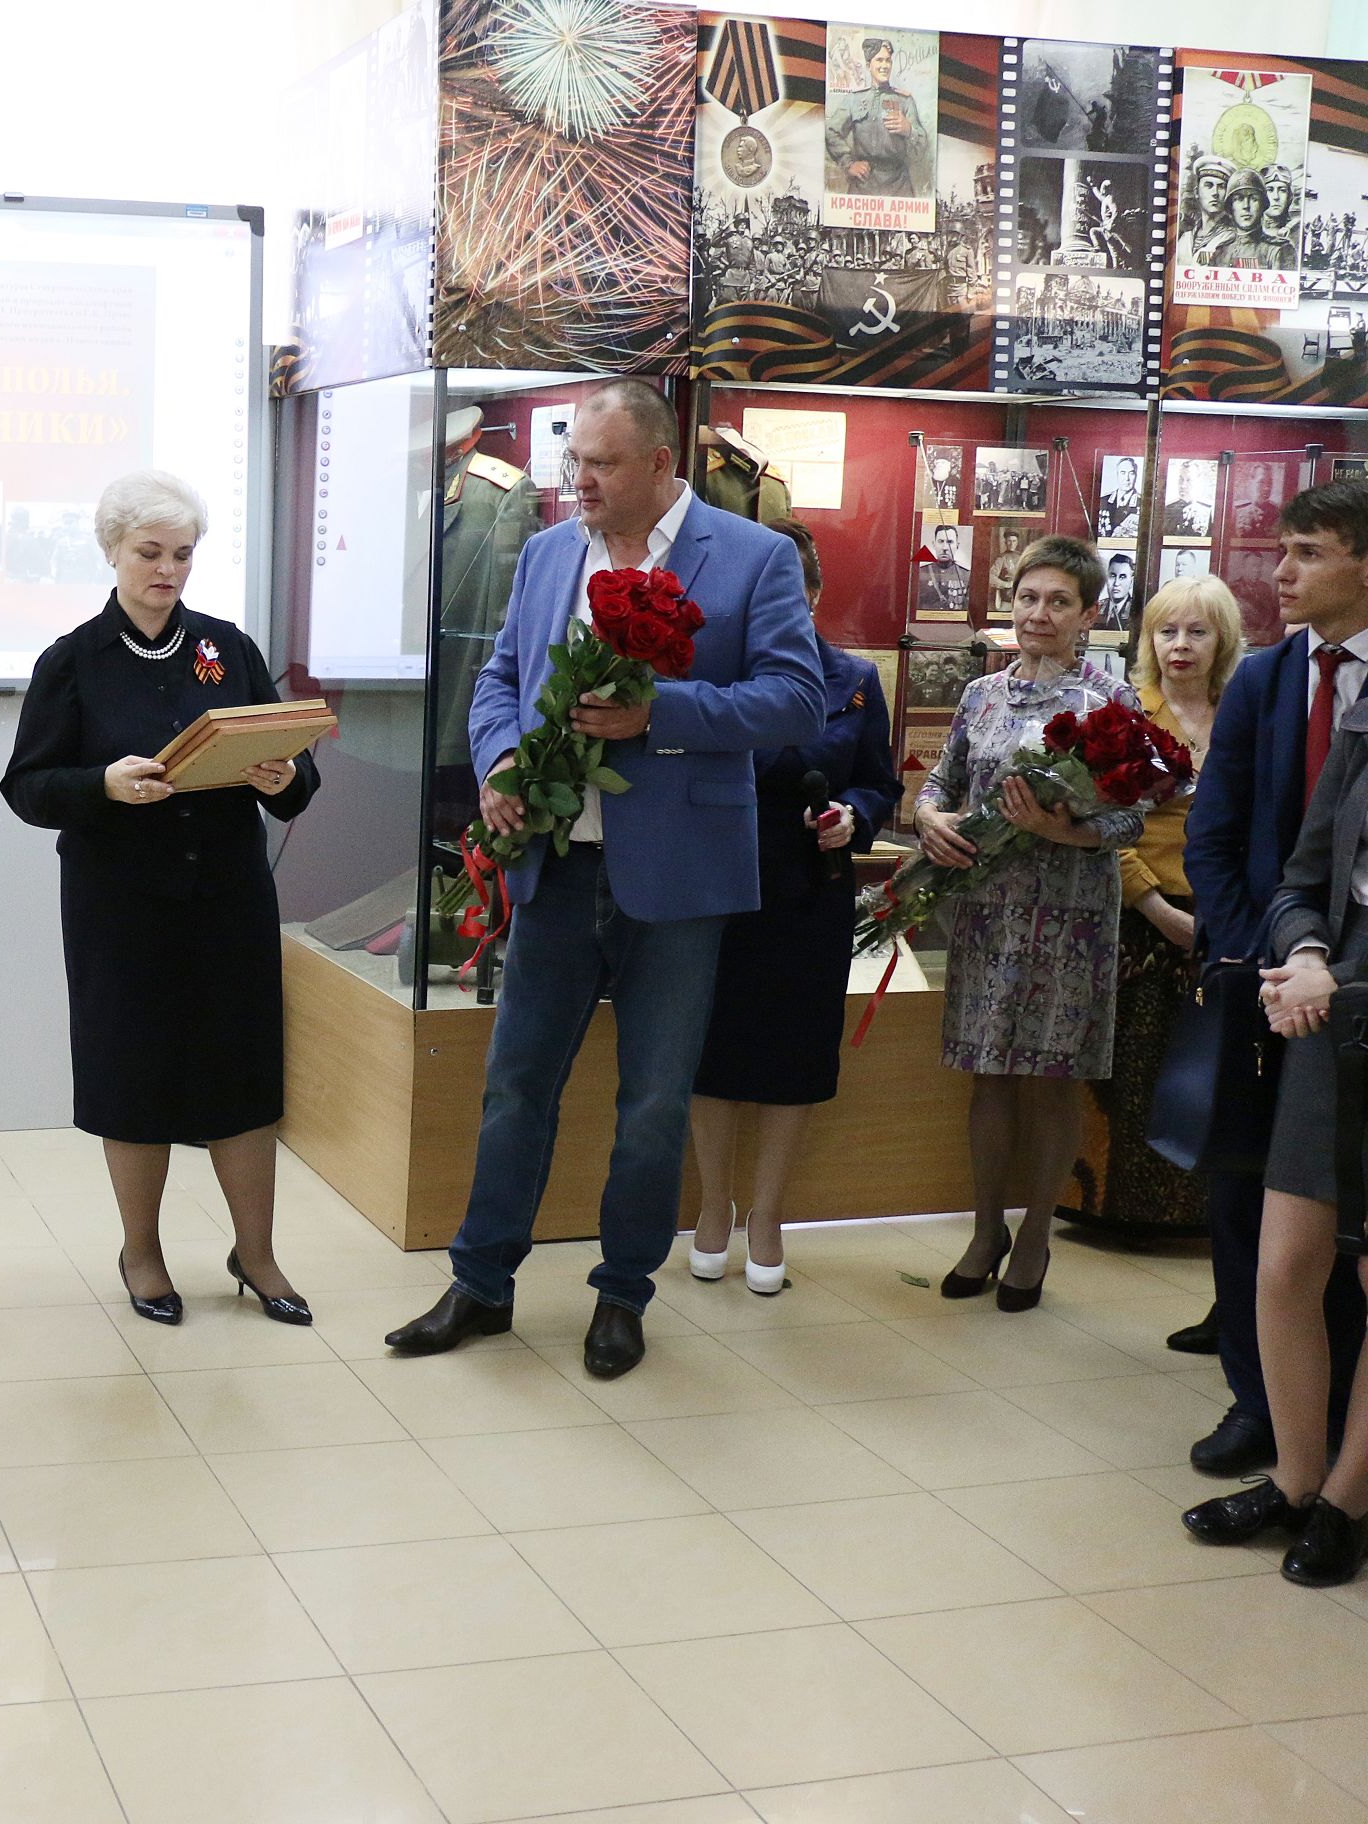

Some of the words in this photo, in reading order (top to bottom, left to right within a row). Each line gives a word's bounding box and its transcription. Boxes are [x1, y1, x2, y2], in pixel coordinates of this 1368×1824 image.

[831, 197, 885, 212] КРАСНОЙ
[889, 200, 930, 214] АРМИИ
[853, 212, 908, 229] СЛАВА!
[1183, 269, 1288, 284] СЛАВА
[1272, 286, 1296, 296] СССР
